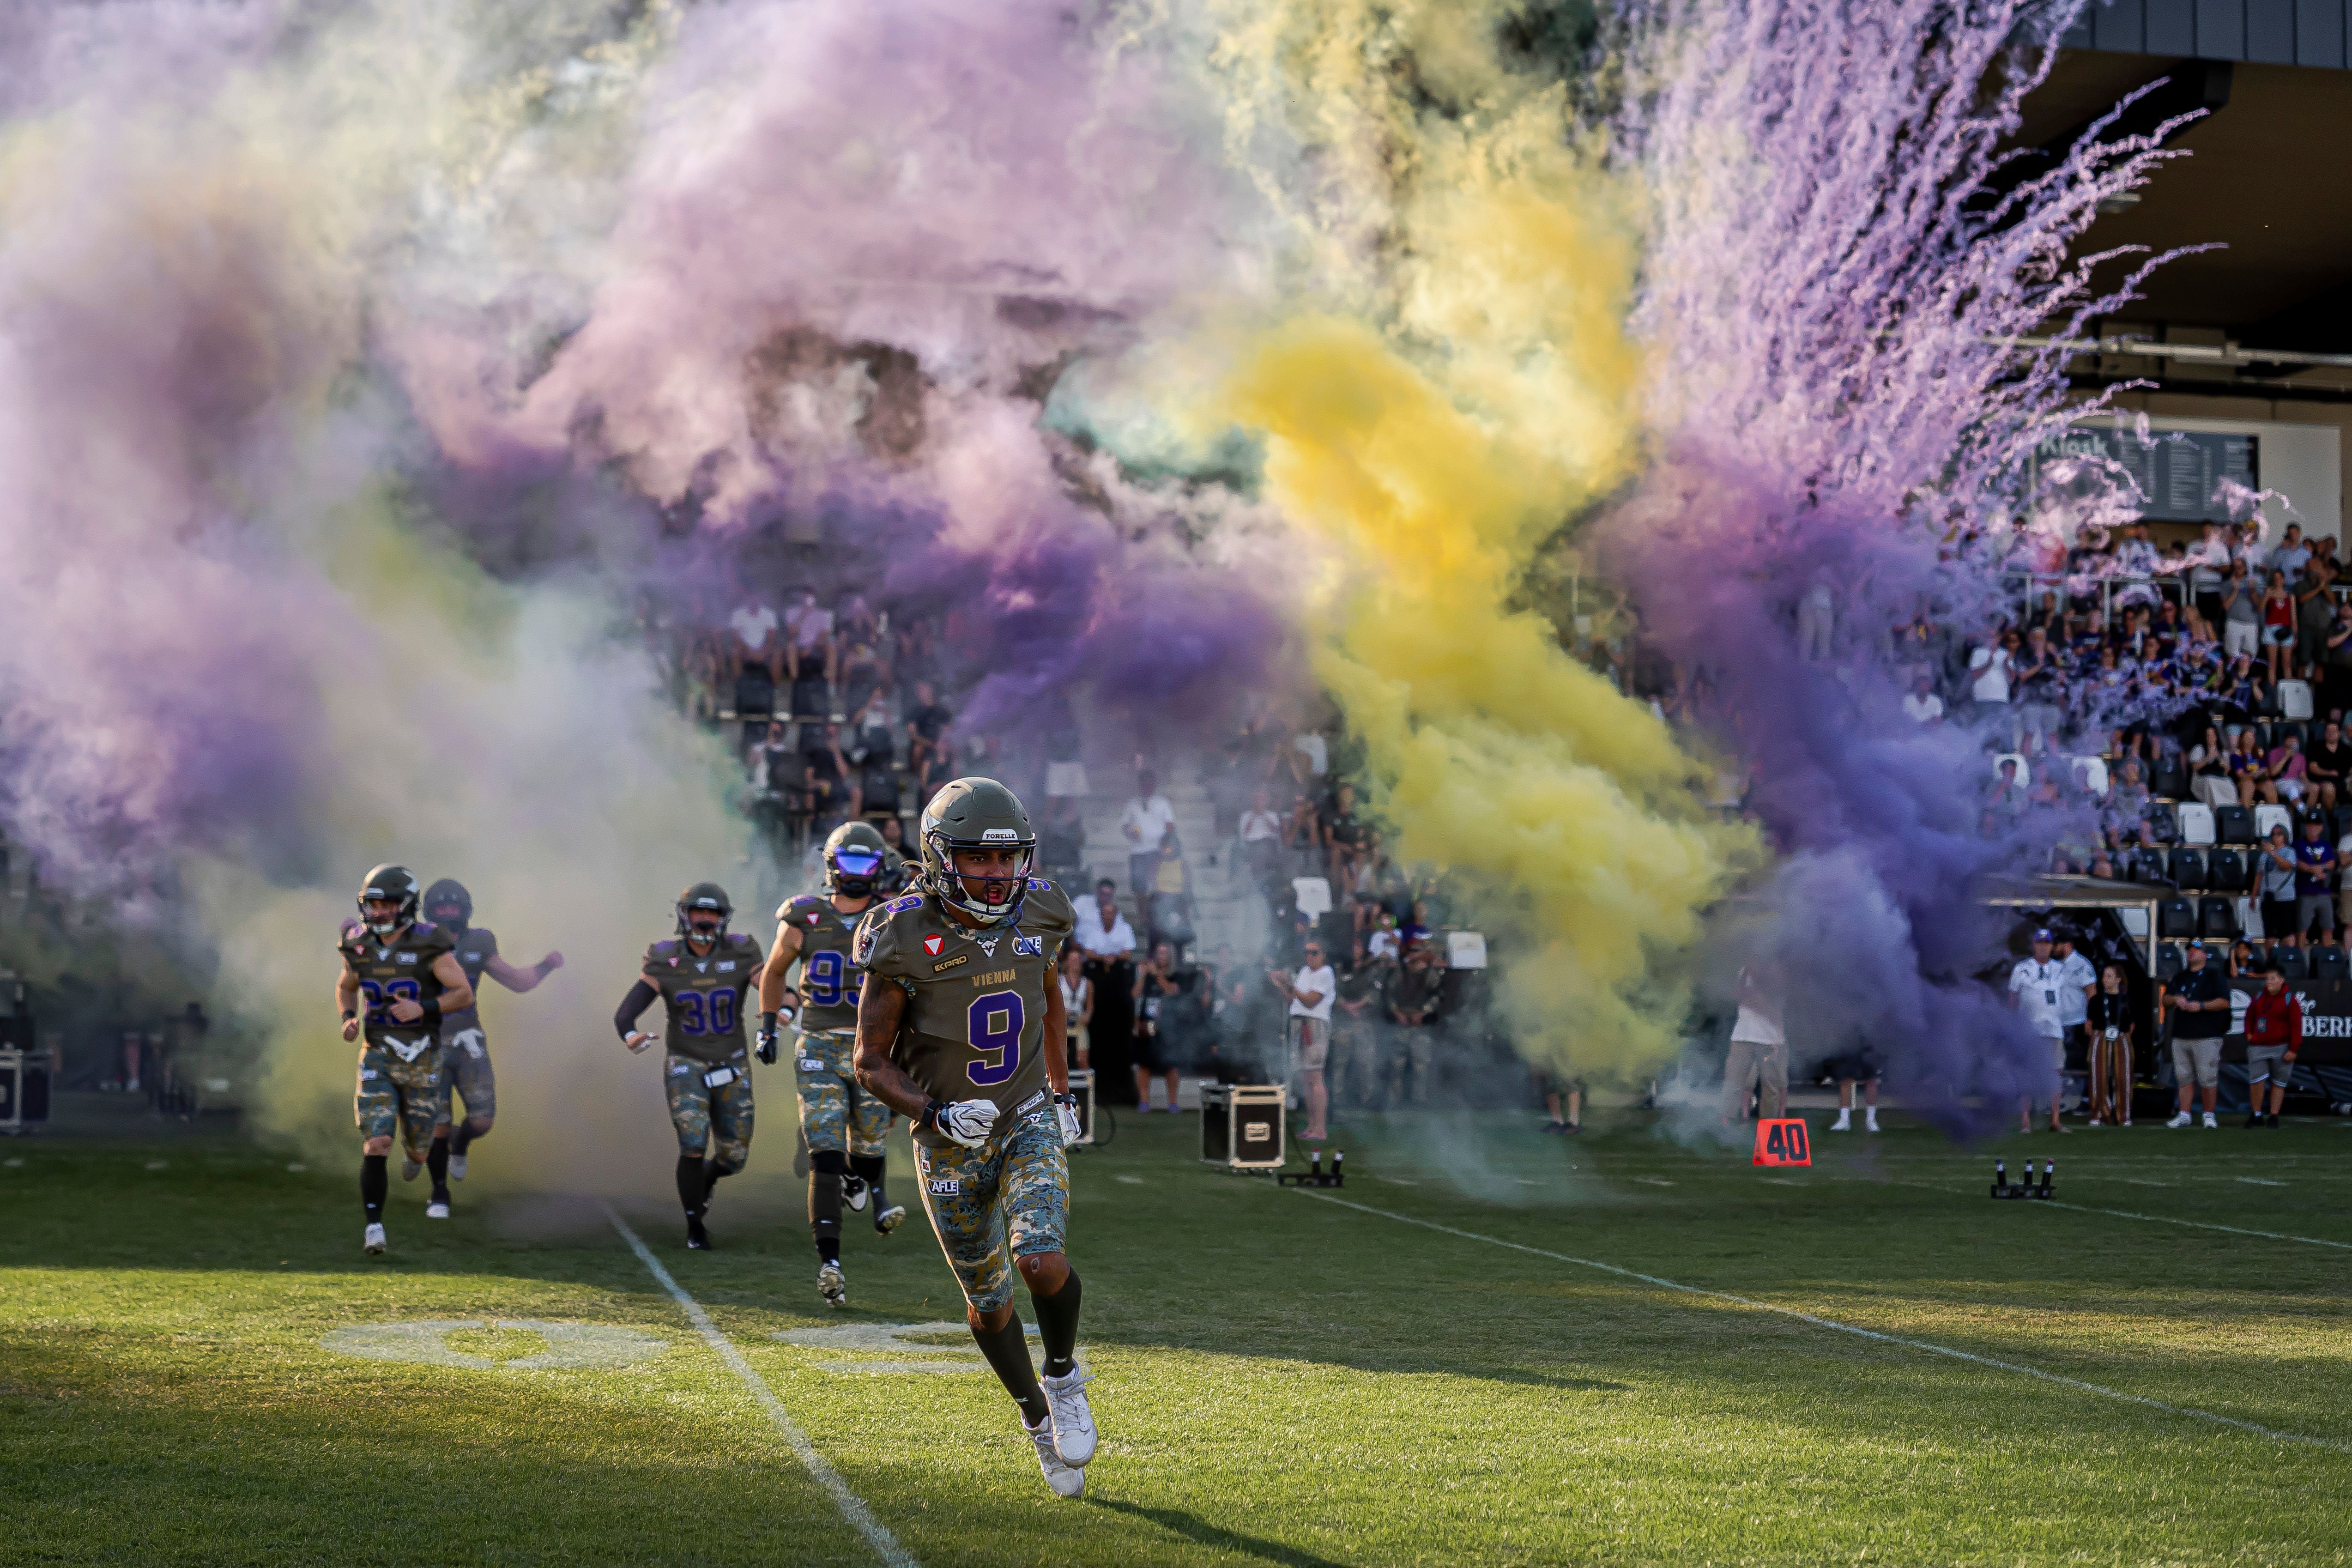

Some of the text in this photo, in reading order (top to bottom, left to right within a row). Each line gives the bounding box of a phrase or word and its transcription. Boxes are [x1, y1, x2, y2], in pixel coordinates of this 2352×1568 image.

[885, 895, 924, 914] 9
[972, 969, 1016, 987] VIENNA
[675, 987, 737, 1036] 30
[966, 989, 1025, 1086] 9
[1767, 1124, 1807, 1161] 40
[932, 1181, 956, 1192] AFLE
